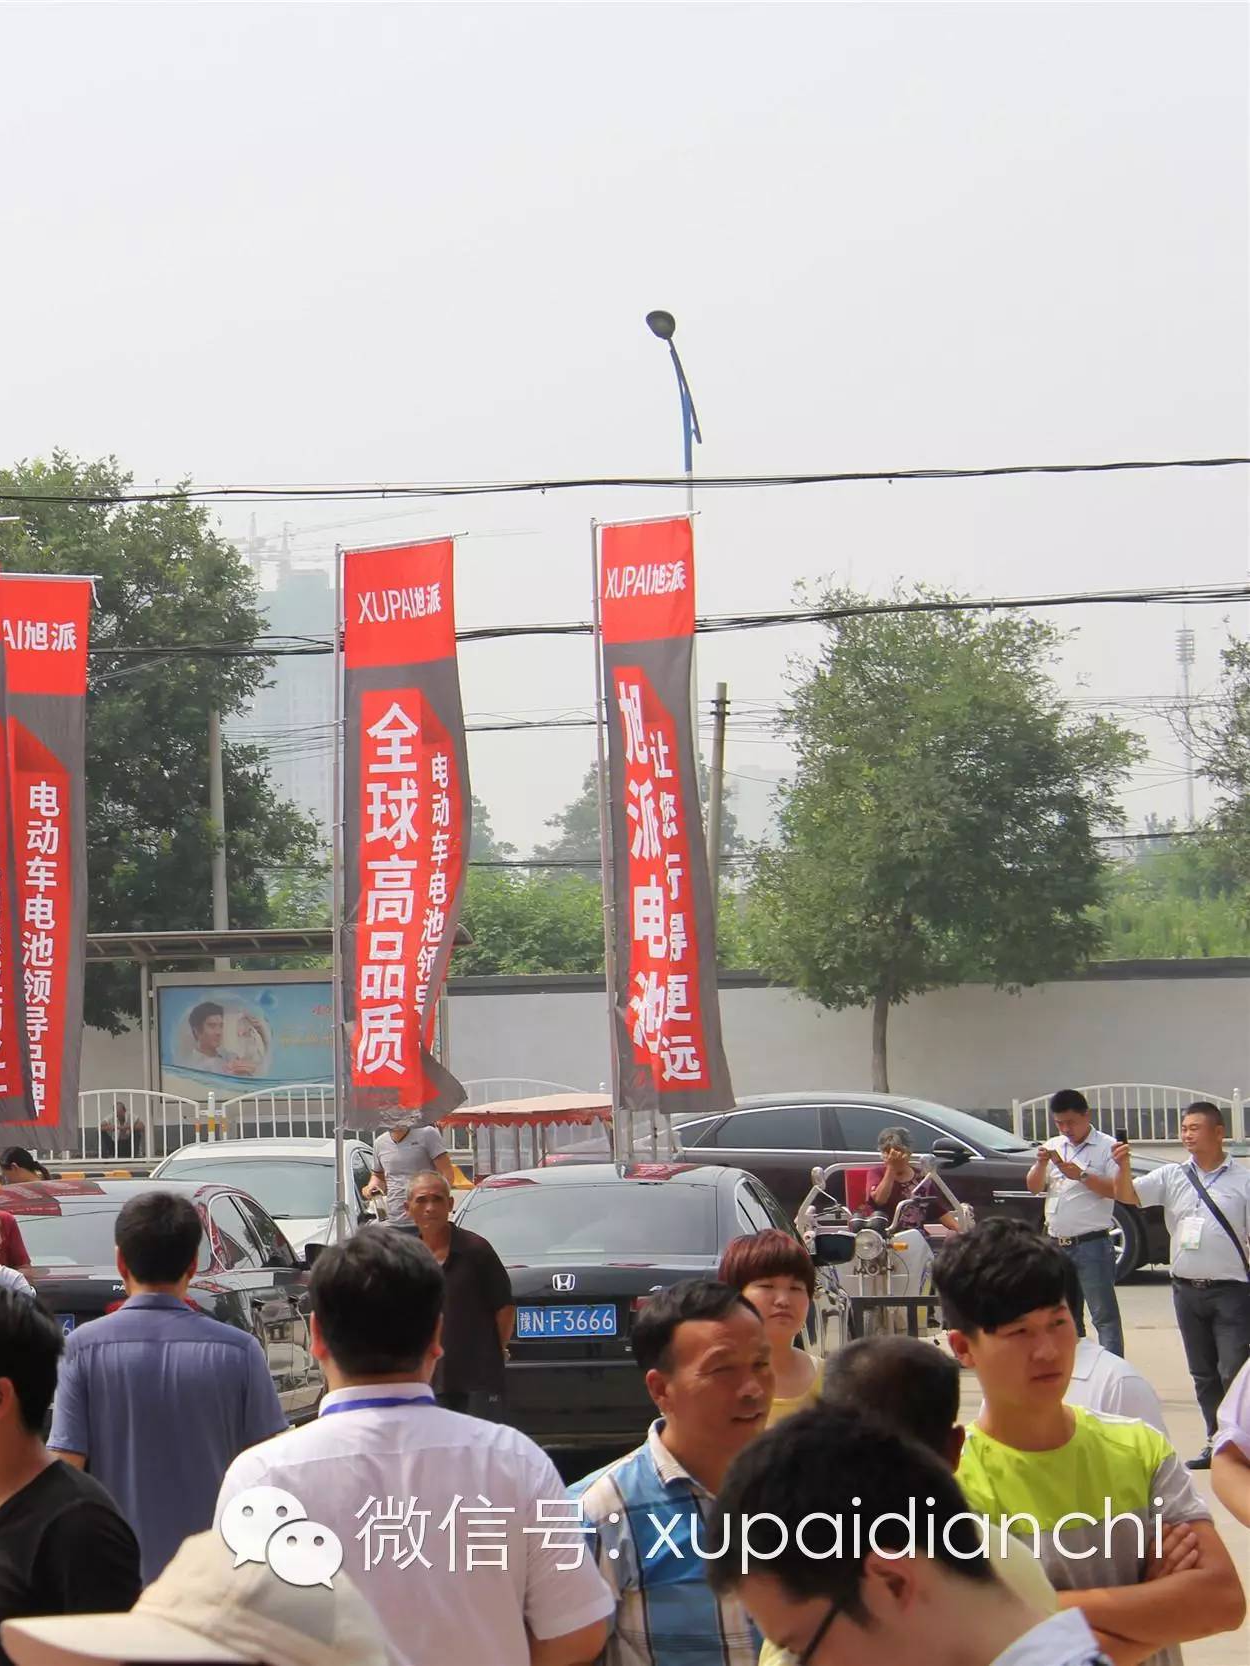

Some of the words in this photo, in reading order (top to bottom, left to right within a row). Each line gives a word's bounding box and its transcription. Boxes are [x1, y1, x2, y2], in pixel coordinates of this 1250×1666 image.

[356, 701, 419, 1076] 全球高品质
